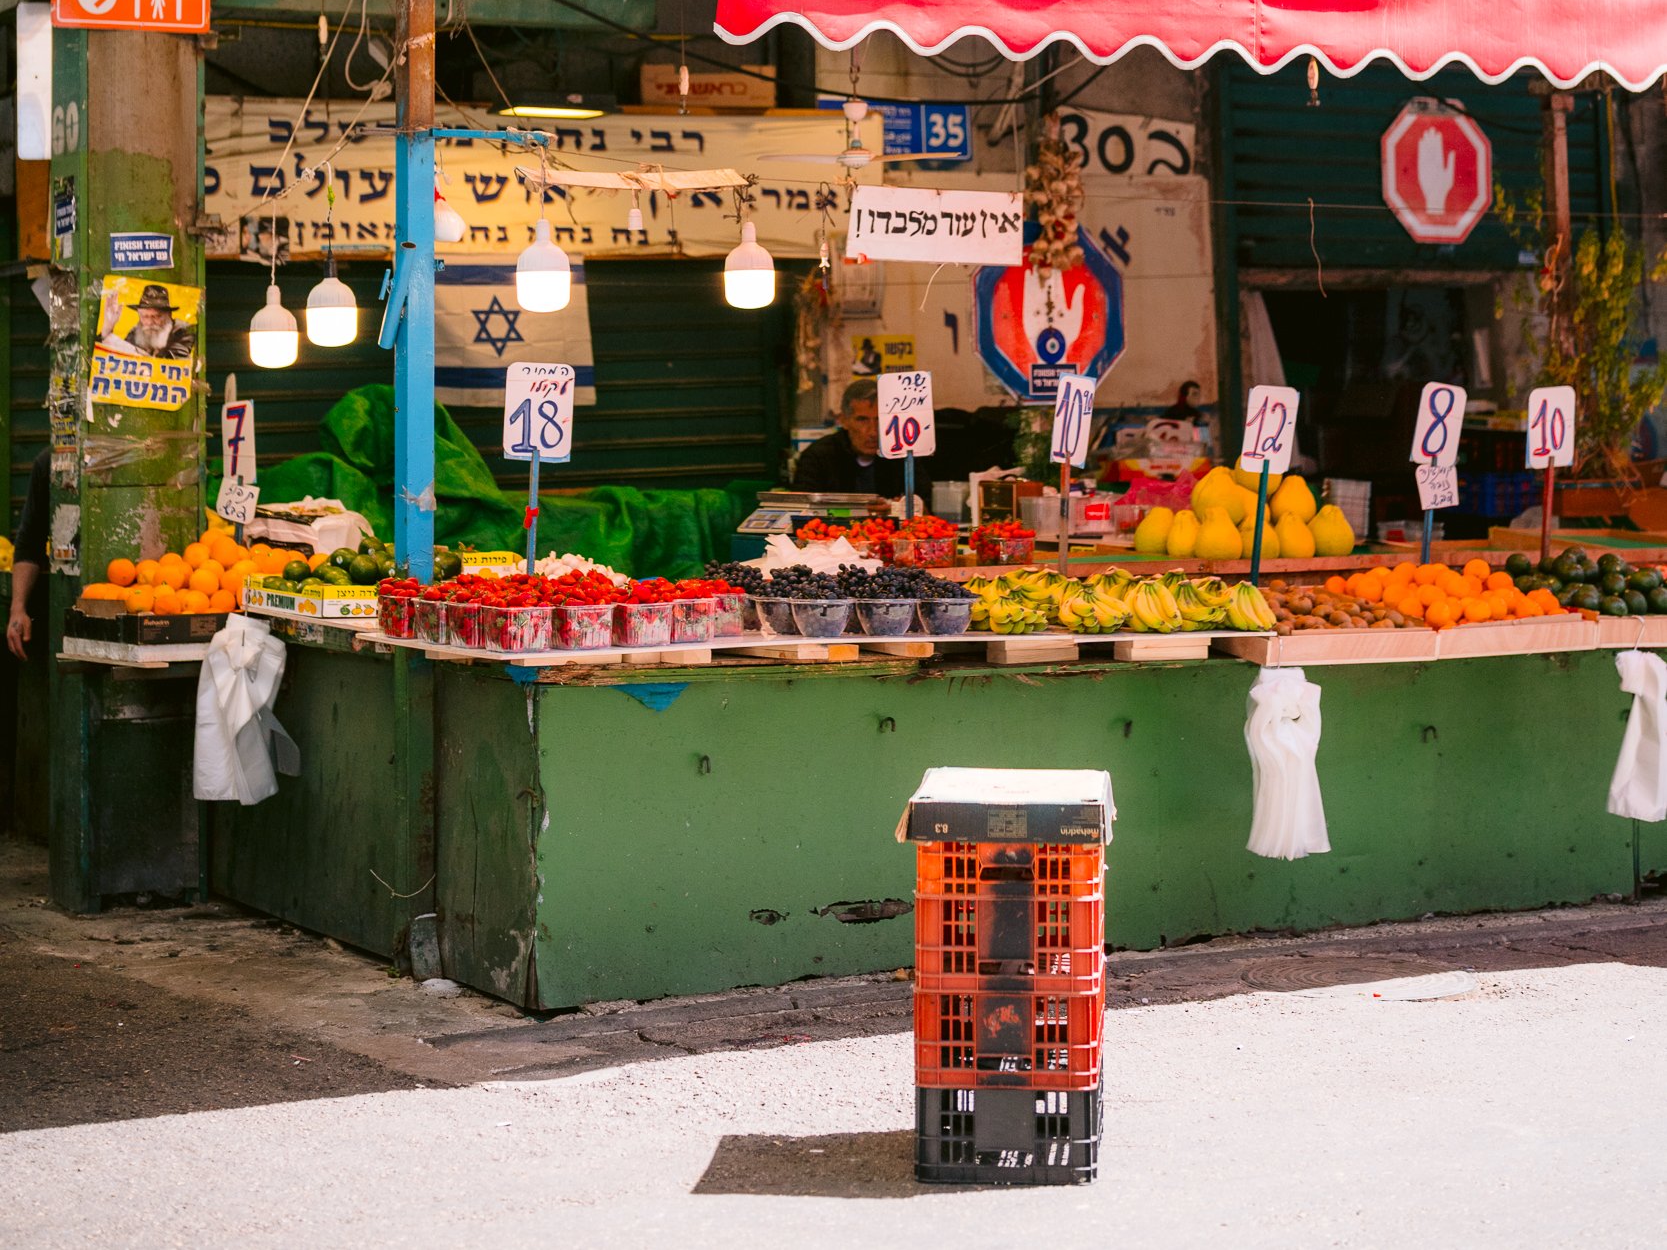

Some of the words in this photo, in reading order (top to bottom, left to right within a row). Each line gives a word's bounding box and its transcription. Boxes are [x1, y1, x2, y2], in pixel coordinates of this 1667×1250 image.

[52, 101, 79, 156] 60
[630, 128, 705, 153] רבי
[927, 112, 965, 148] 35
[249, 152, 394, 204] עולם
[940, 210, 977, 238] עוד
[980, 208, 1021, 239] אין
[113, 239, 143, 251] FINISH
[143, 239, 168, 250] THEM
[114, 252, 125, 262] חי
[126, 251, 155, 262] ישראל
[94, 355, 153, 378] המלך
[160, 362, 190, 382] יחי
[522, 365, 570, 376] המחיר
[90, 375, 188, 405] המשיח
[1053, 381, 1083, 458] 10
[1421, 387, 1455, 458] 8
[1531, 398, 1566, 457] 10
[226, 404, 247, 477] 7
[463, 556, 477, 564] ניצ
[266, 592, 296, 611] PREMIUM
[1060, 827, 1100, 838] mehadrin
